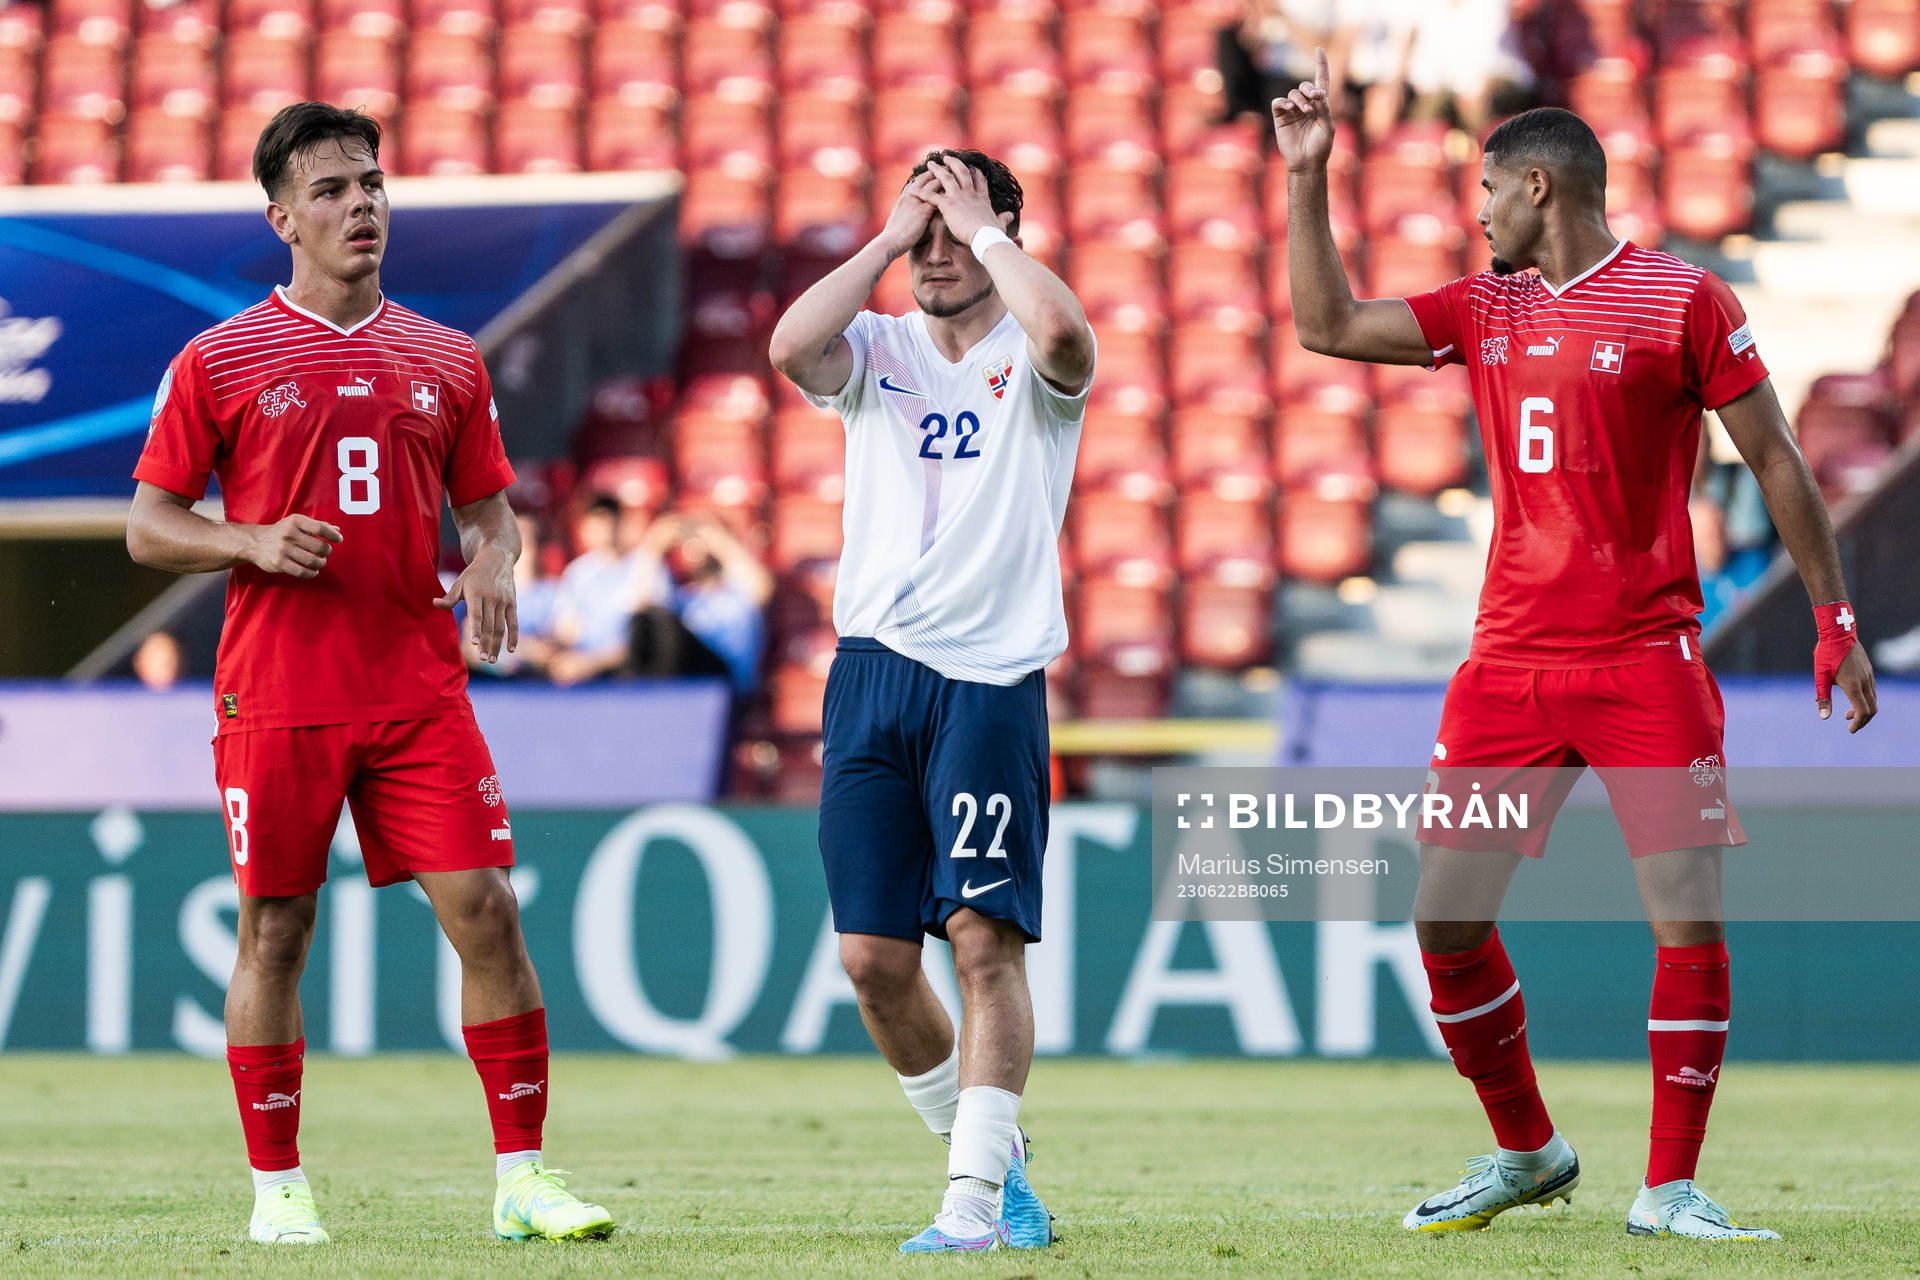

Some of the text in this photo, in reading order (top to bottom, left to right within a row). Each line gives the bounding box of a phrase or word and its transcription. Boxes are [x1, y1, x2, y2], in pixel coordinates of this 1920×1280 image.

[1526, 345, 1555, 356] PUMA
[336, 386, 370, 397] PUMA
[918, 411, 981, 460] 22
[1518, 397, 1554, 473] 6
[337, 436, 381, 515] 8
[225, 787, 249, 867] 8
[950, 792, 1012, 859] 22
[252, 1100, 290, 1111] PUMA
[499, 1088, 534, 1101] PUMA
